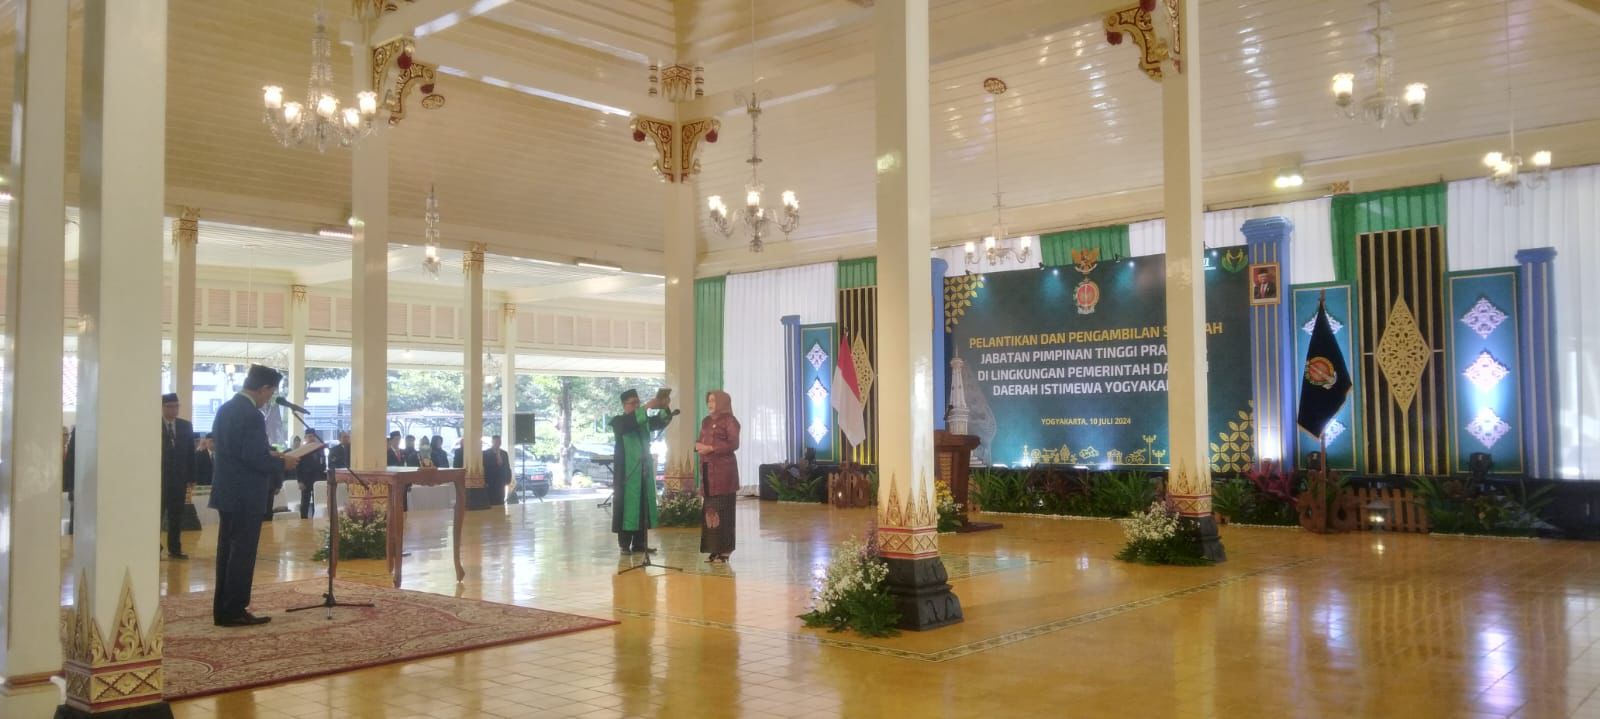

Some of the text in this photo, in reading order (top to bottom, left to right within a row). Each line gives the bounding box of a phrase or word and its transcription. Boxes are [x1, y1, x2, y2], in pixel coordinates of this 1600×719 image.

[969, 335, 1038, 348] PELANTIKAN
[1041, 333, 1066, 345] DAN
[1069, 326, 1160, 343] PENGAMBILAN
[981, 352, 1030, 364] JABATAN
[1033, 349, 1093, 362] PIMPINAN
[1095, 346, 1137, 359] TINGGI
[978, 370, 989, 381] DI
[991, 367, 1065, 381] LINGKUNGAN
[1068, 364, 1150, 378] PEMERINTAH
[993, 380, 1169, 396] DAERAH ISTIMEWA YOGYAKA
[1041, 418, 1088, 426] YOGYAKARTA,
[1098, 418, 1113, 426] JULI
[1114, 417, 1131, 425] 2024
